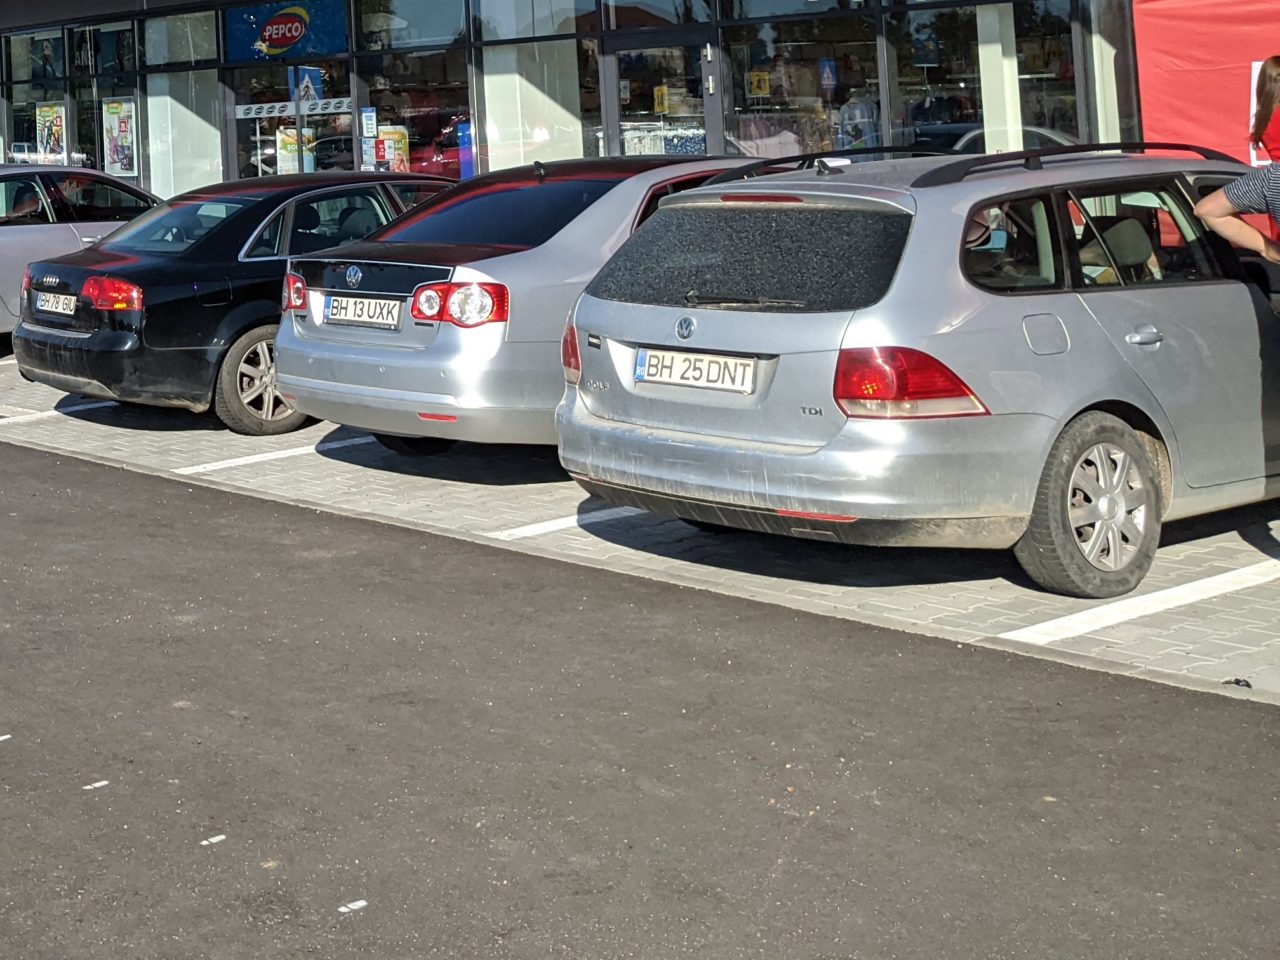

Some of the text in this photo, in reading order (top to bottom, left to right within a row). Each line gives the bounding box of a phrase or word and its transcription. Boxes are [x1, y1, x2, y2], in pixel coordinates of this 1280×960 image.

[265, 22, 302, 40] PEPCO
[330, 298, 349, 317] BH
[353, 300, 365, 318] 13
[367, 301, 397, 321] UXK
[646, 354, 674, 379] BH
[680, 357, 704, 381] 25
[706, 360, 751, 386] DNT
[800, 406, 823, 416] TDI
